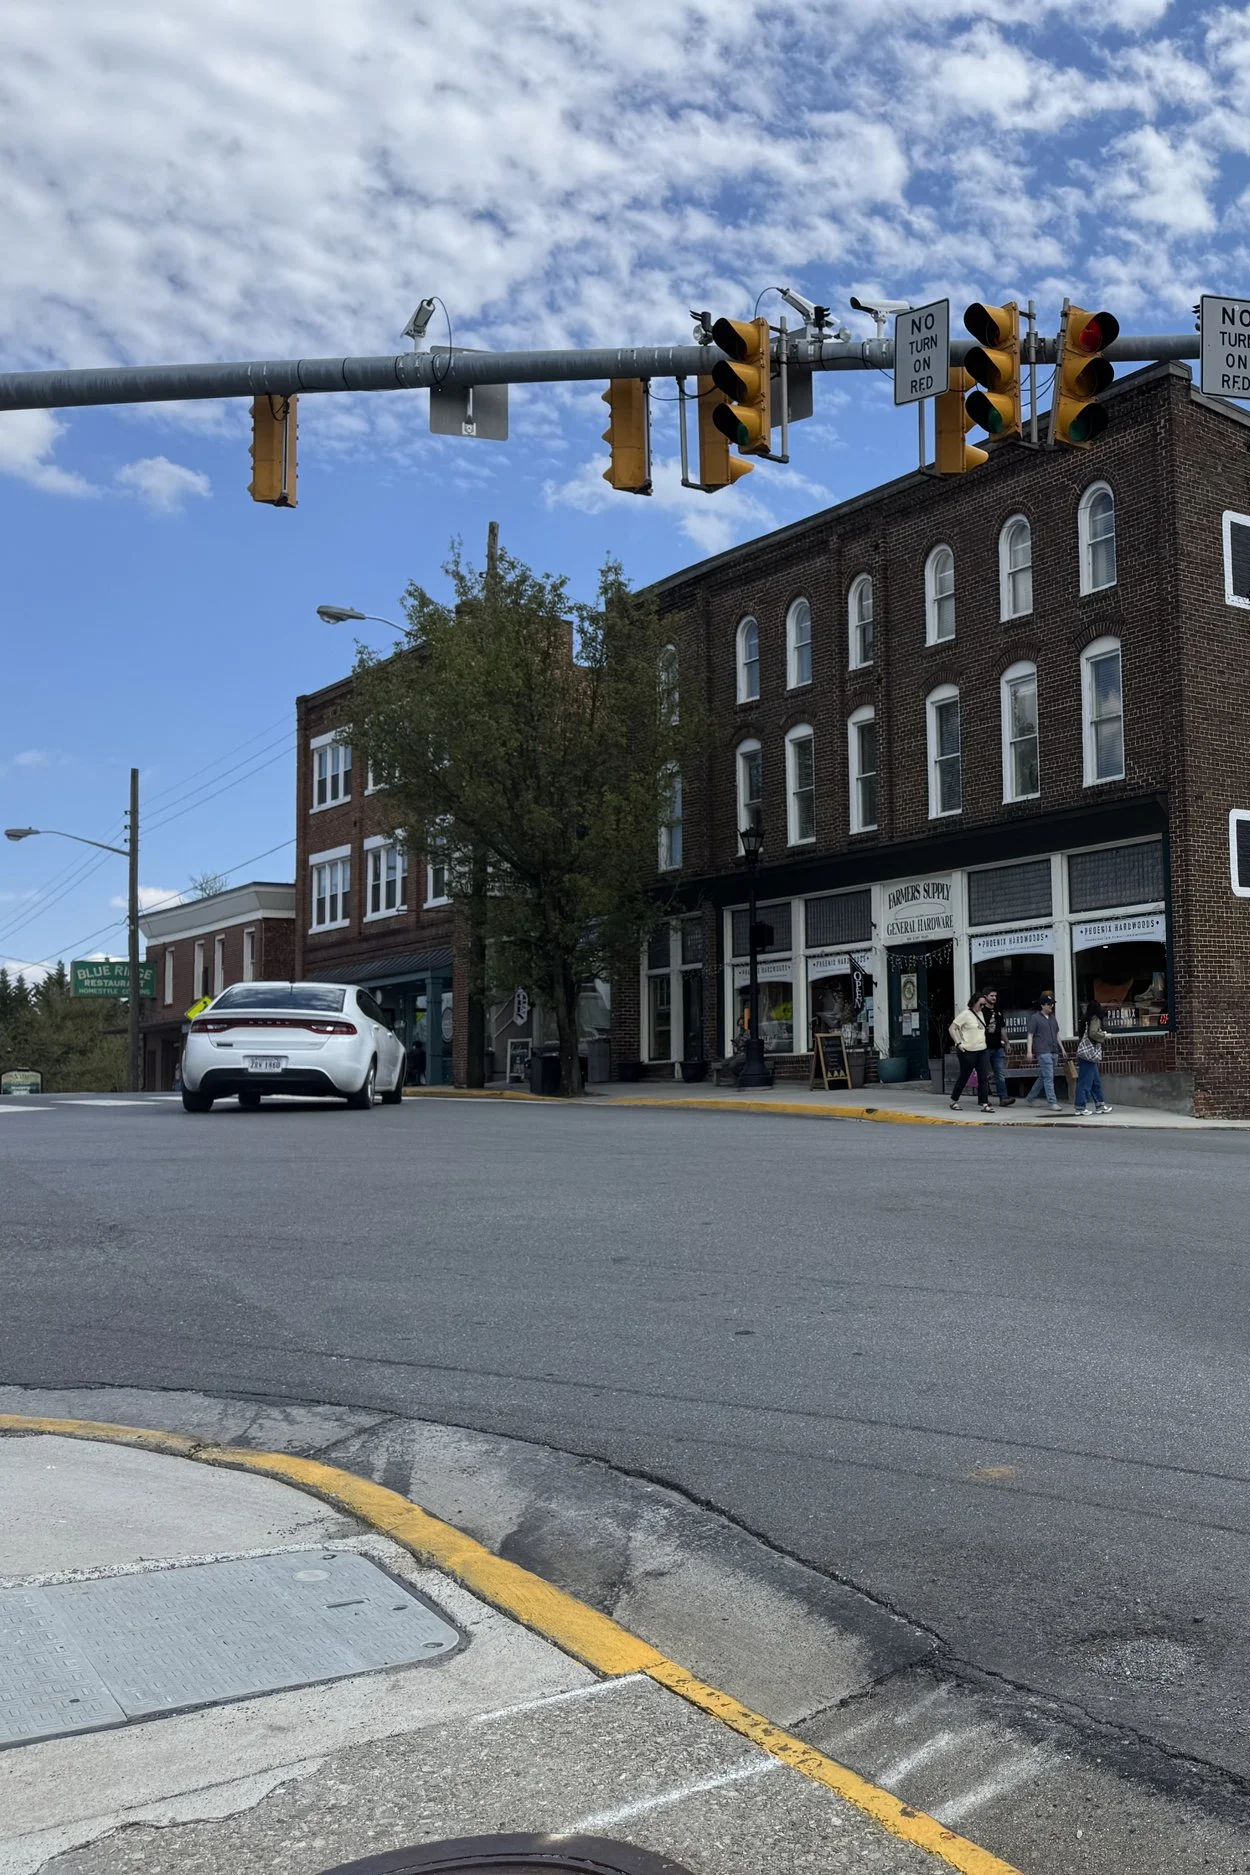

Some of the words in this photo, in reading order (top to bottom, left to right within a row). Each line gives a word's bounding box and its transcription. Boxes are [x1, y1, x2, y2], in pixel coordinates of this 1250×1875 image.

[911, 312, 935, 335] NO
[909, 333, 938, 355] TURN
[913, 356, 931, 373] ON
[1225, 352, 1248, 370] ON
[888, 883, 920, 910] FARMERS
[922, 882, 952, 901] SUPPLY
[886, 920, 916, 937] GENERAL
[917, 914, 954, 932] HARDWARE
[1084, 924, 1112, 936] PHOENIX
[1114, 919, 1155, 932] HARDWOODS
[982, 937, 1006, 948] PHOENIX
[1008, 933, 1044, 945] HARDWOODS
[77, 965, 111, 980] BLUE
[853, 971, 862, 1009] OPEN
